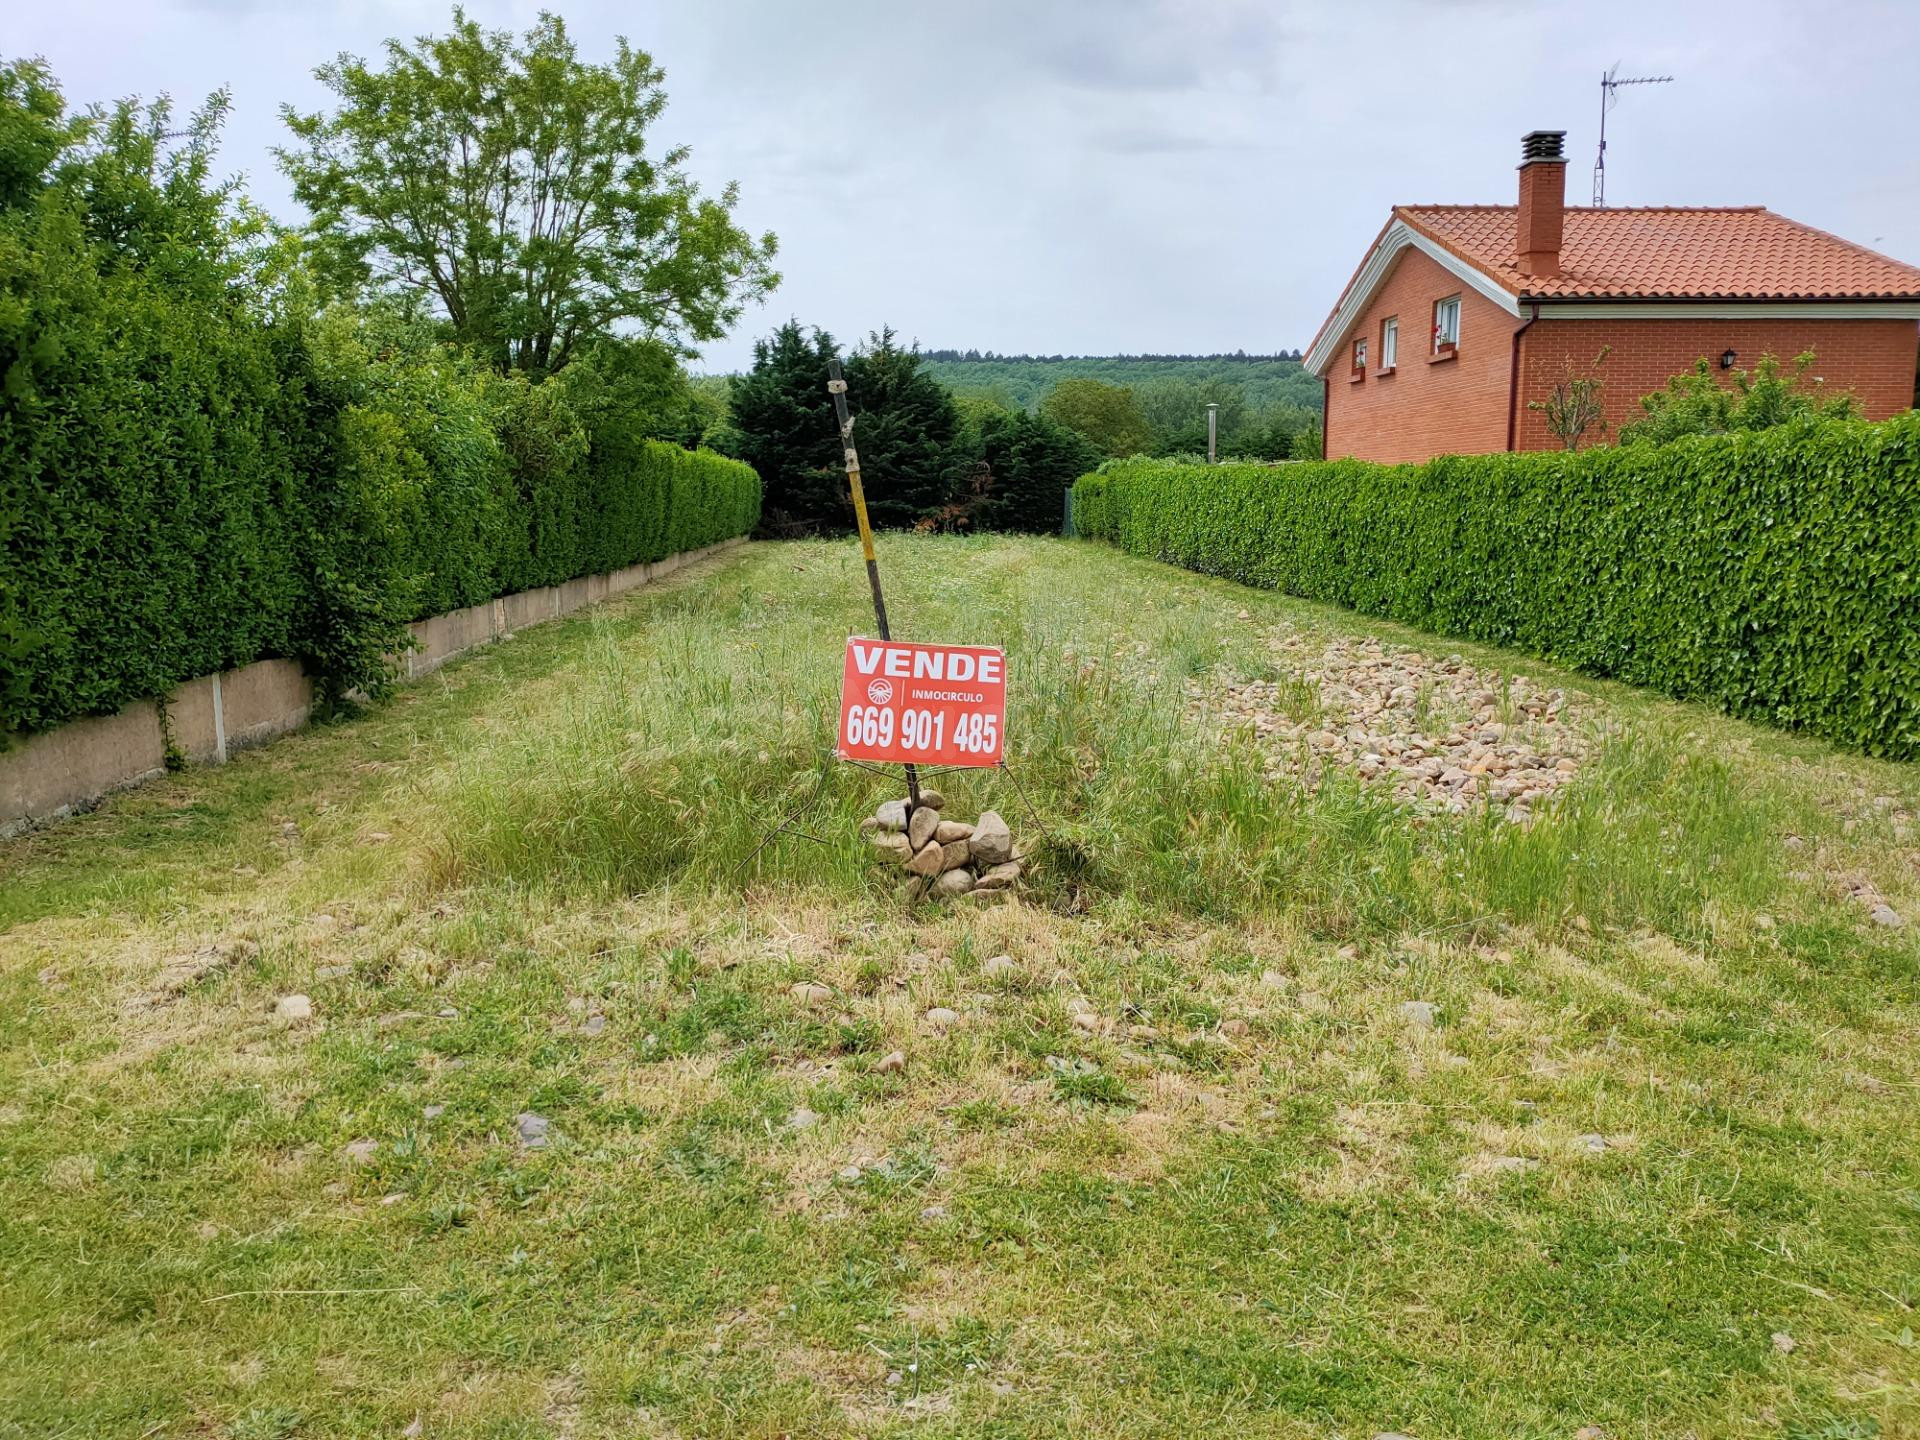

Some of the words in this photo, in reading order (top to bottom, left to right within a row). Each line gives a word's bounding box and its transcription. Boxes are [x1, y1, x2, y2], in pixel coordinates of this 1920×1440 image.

[853, 646, 1001, 683] VENDE
[912, 689, 983, 703] INMOCIRCULO
[847, 704, 895, 748] 669
[901, 708, 945, 751] 901
[953, 713, 997, 754] 485
